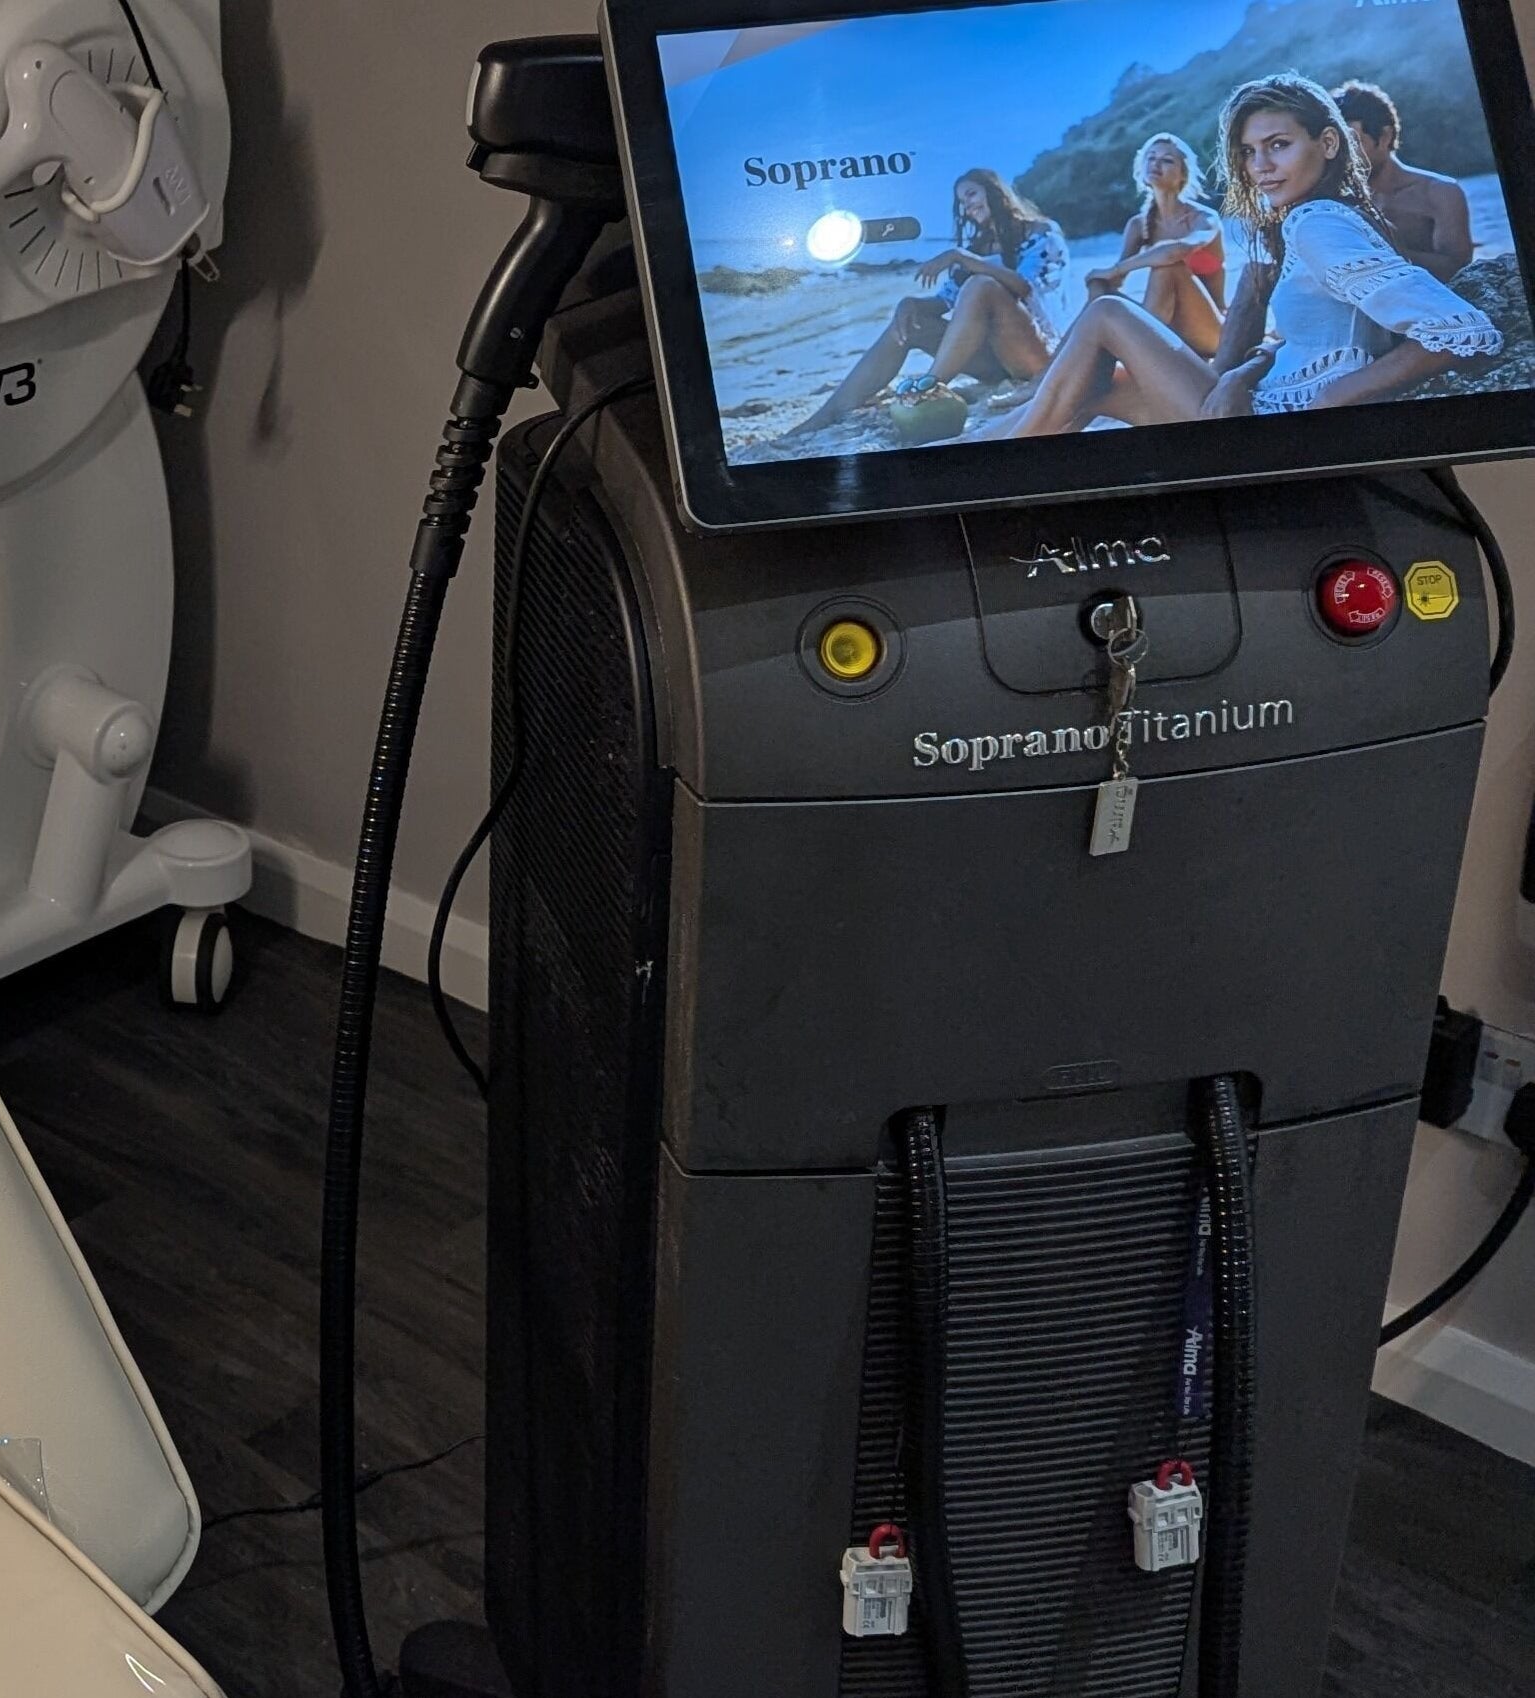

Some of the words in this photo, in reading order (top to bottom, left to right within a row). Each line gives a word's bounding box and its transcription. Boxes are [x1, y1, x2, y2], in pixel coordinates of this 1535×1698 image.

[743, 152, 912, 190] Soprano
[1009, 535, 1170, 579] Alma
[1416, 574, 1443, 586] STOP
[913, 724, 1110, 771] Soprano
[1117, 698, 1294, 745] Titanium
[1183, 1325, 1203, 1376] Alma
